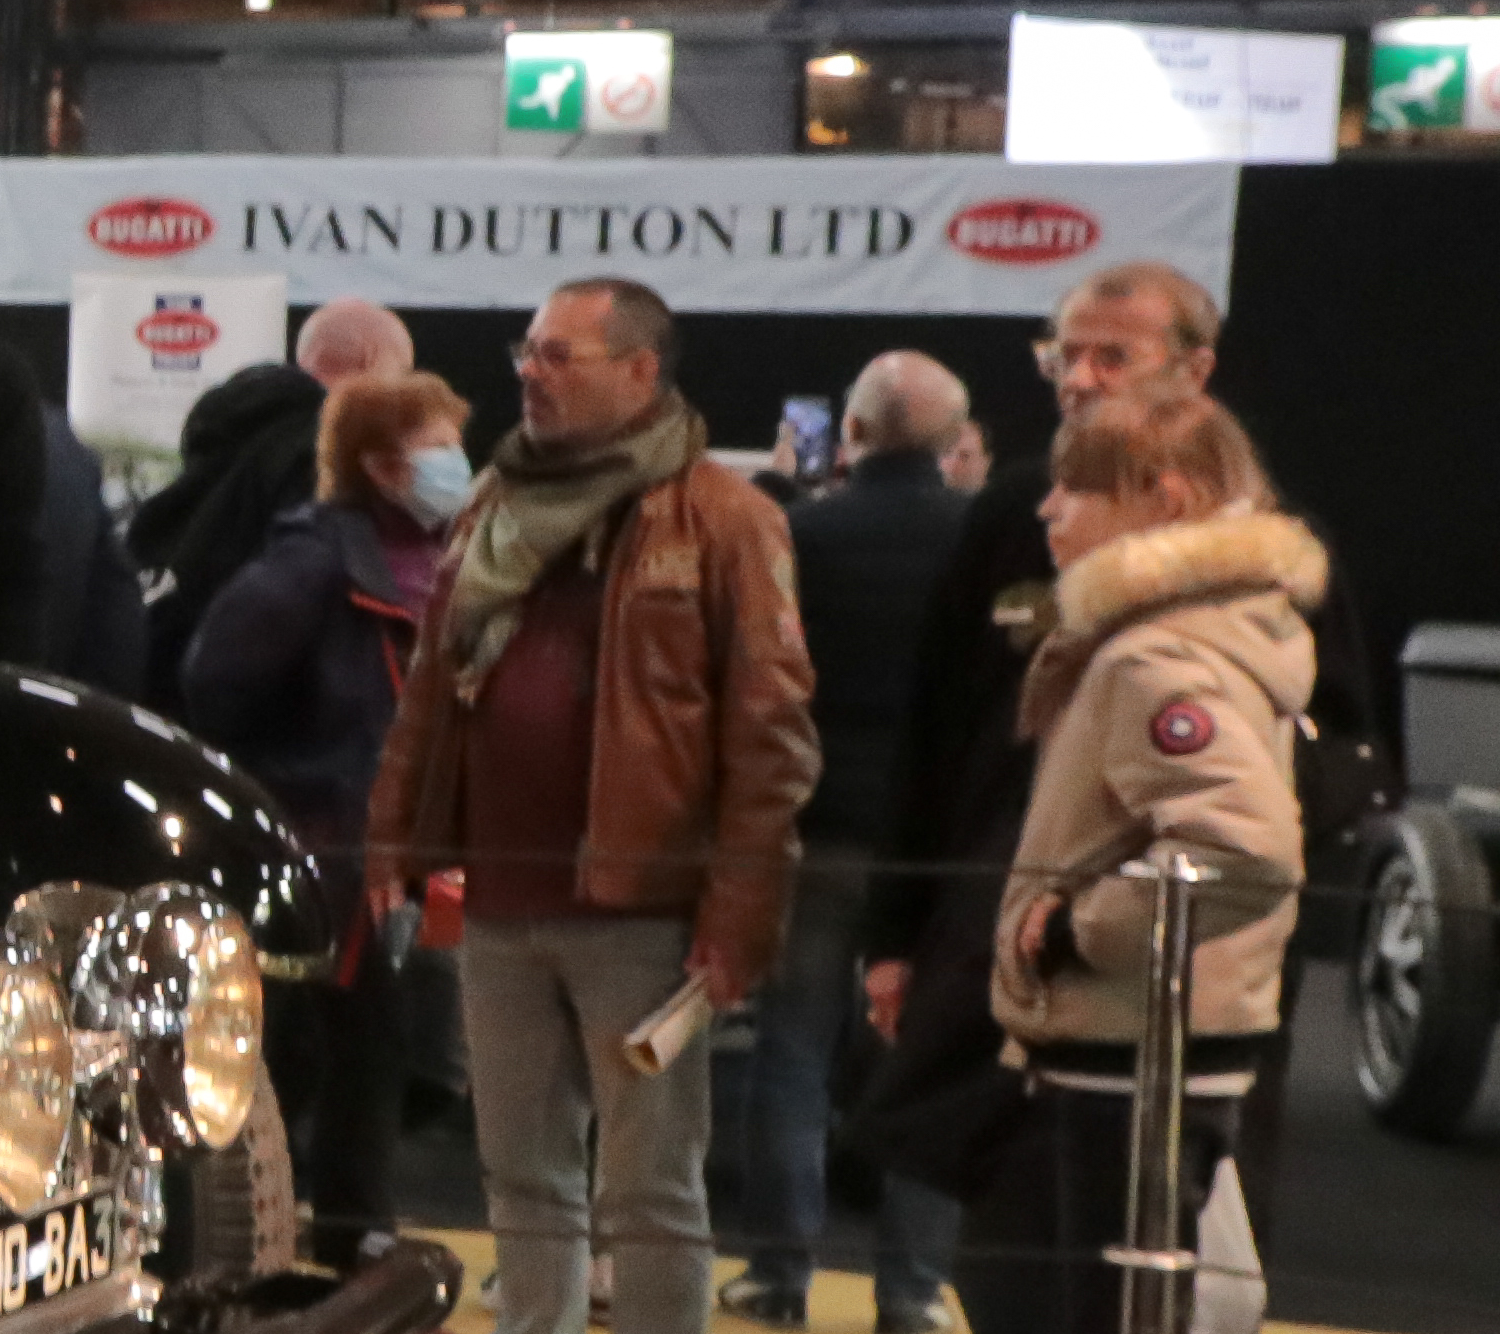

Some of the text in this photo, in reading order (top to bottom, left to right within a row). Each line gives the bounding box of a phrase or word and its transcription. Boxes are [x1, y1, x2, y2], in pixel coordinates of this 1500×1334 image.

[96, 202, 1089, 259] BUGATTI IVAN DUTTON LTD BUGATTI
